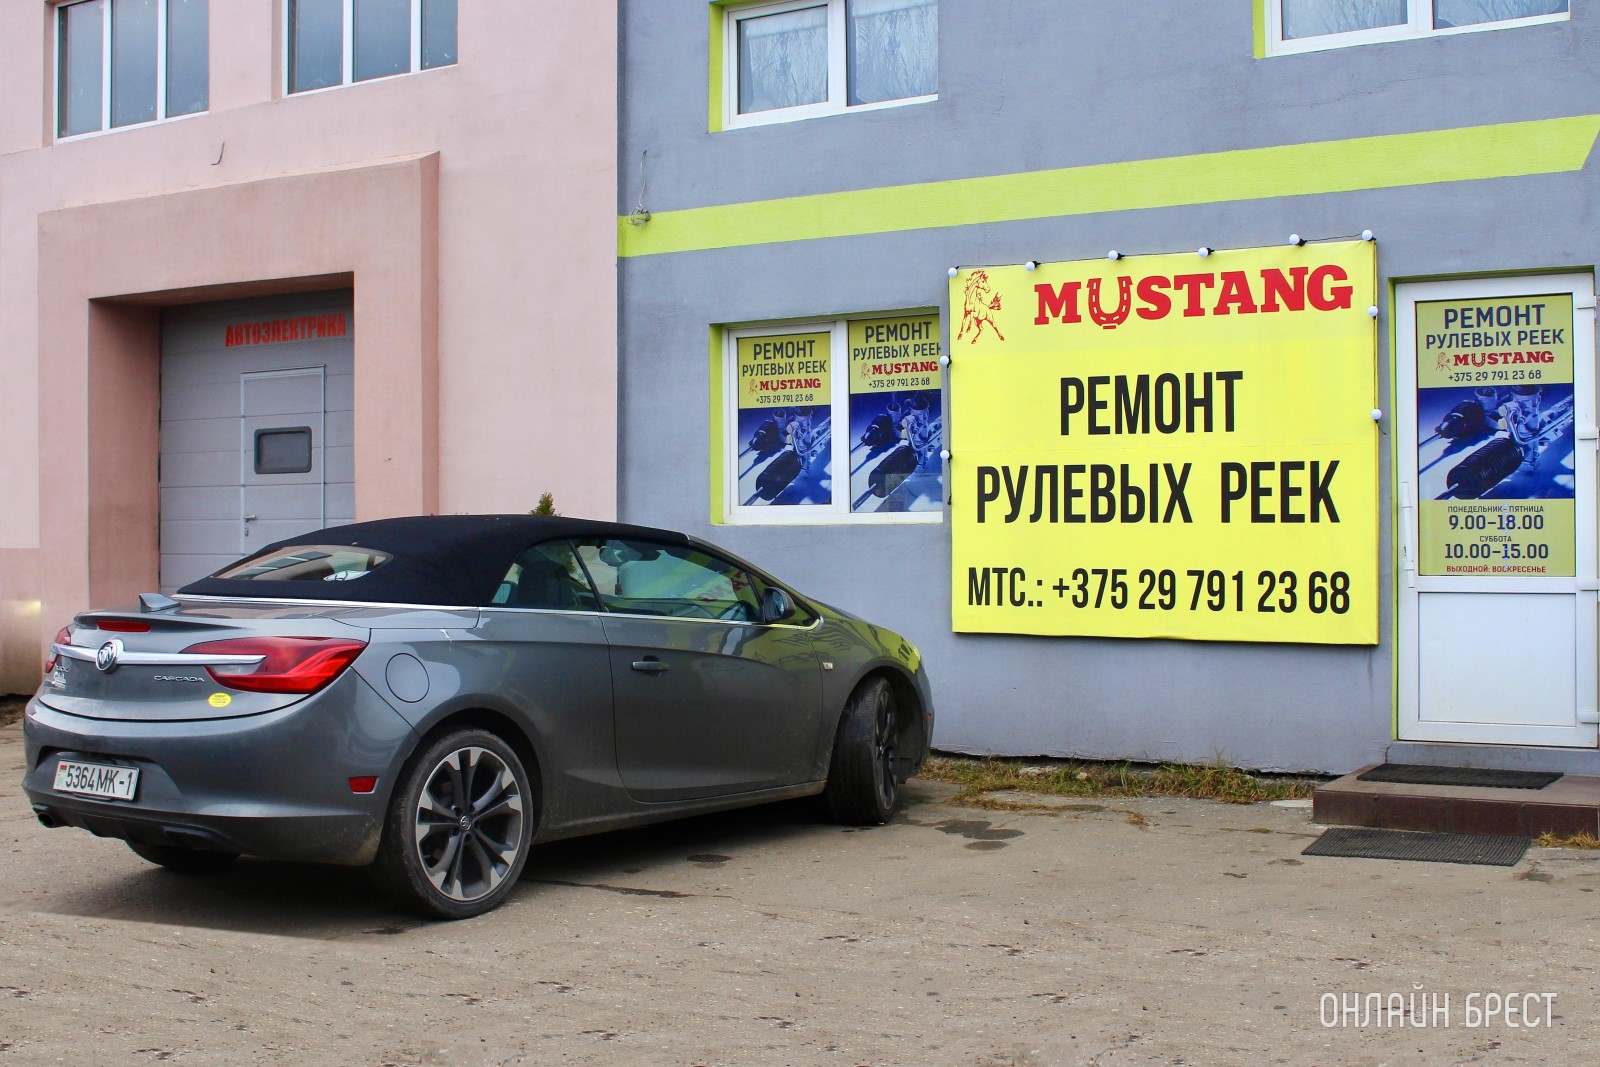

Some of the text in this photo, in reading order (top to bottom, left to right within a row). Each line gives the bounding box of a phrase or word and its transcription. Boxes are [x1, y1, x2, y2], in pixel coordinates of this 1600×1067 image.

[1034, 265, 1354, 330] MUSTANG
[1444, 304, 1546, 329] РЕМОНТ
[225, 312, 347, 347] АВТОЭЛЕКТРИКА
[865, 322, 932, 344] РЕМОНТ
[1426, 329, 1565, 350] РУЛЕВЫХ РЕЕК
[753, 340, 816, 360] РЕМОНТ
[853, 344, 910, 361] РУЛЕВЫХ
[1453, 351, 1554, 367] MUSTANG
[742, 360, 827, 377] РУЛЕВЫХ РЕЕК
[872, 360, 939, 376] MUSTANG
[1448, 370, 1542, 382] +375 29 791 23 68
[759, 378, 821, 392] MUSTANG
[868, 376, 930, 389] +375 29 791 23 68
[756, 393, 814, 404] +375 29 791 23 68
[1060, 370, 1243, 436] РЕМОНТ
[977, 460, 1341, 524] РУЛЕВЫХ РЕЕК
[1446, 565, 1490, 573] ВЫХОДНОЙ:
[968, 567, 1350, 615] МТС.: +375 29 791 23 68
